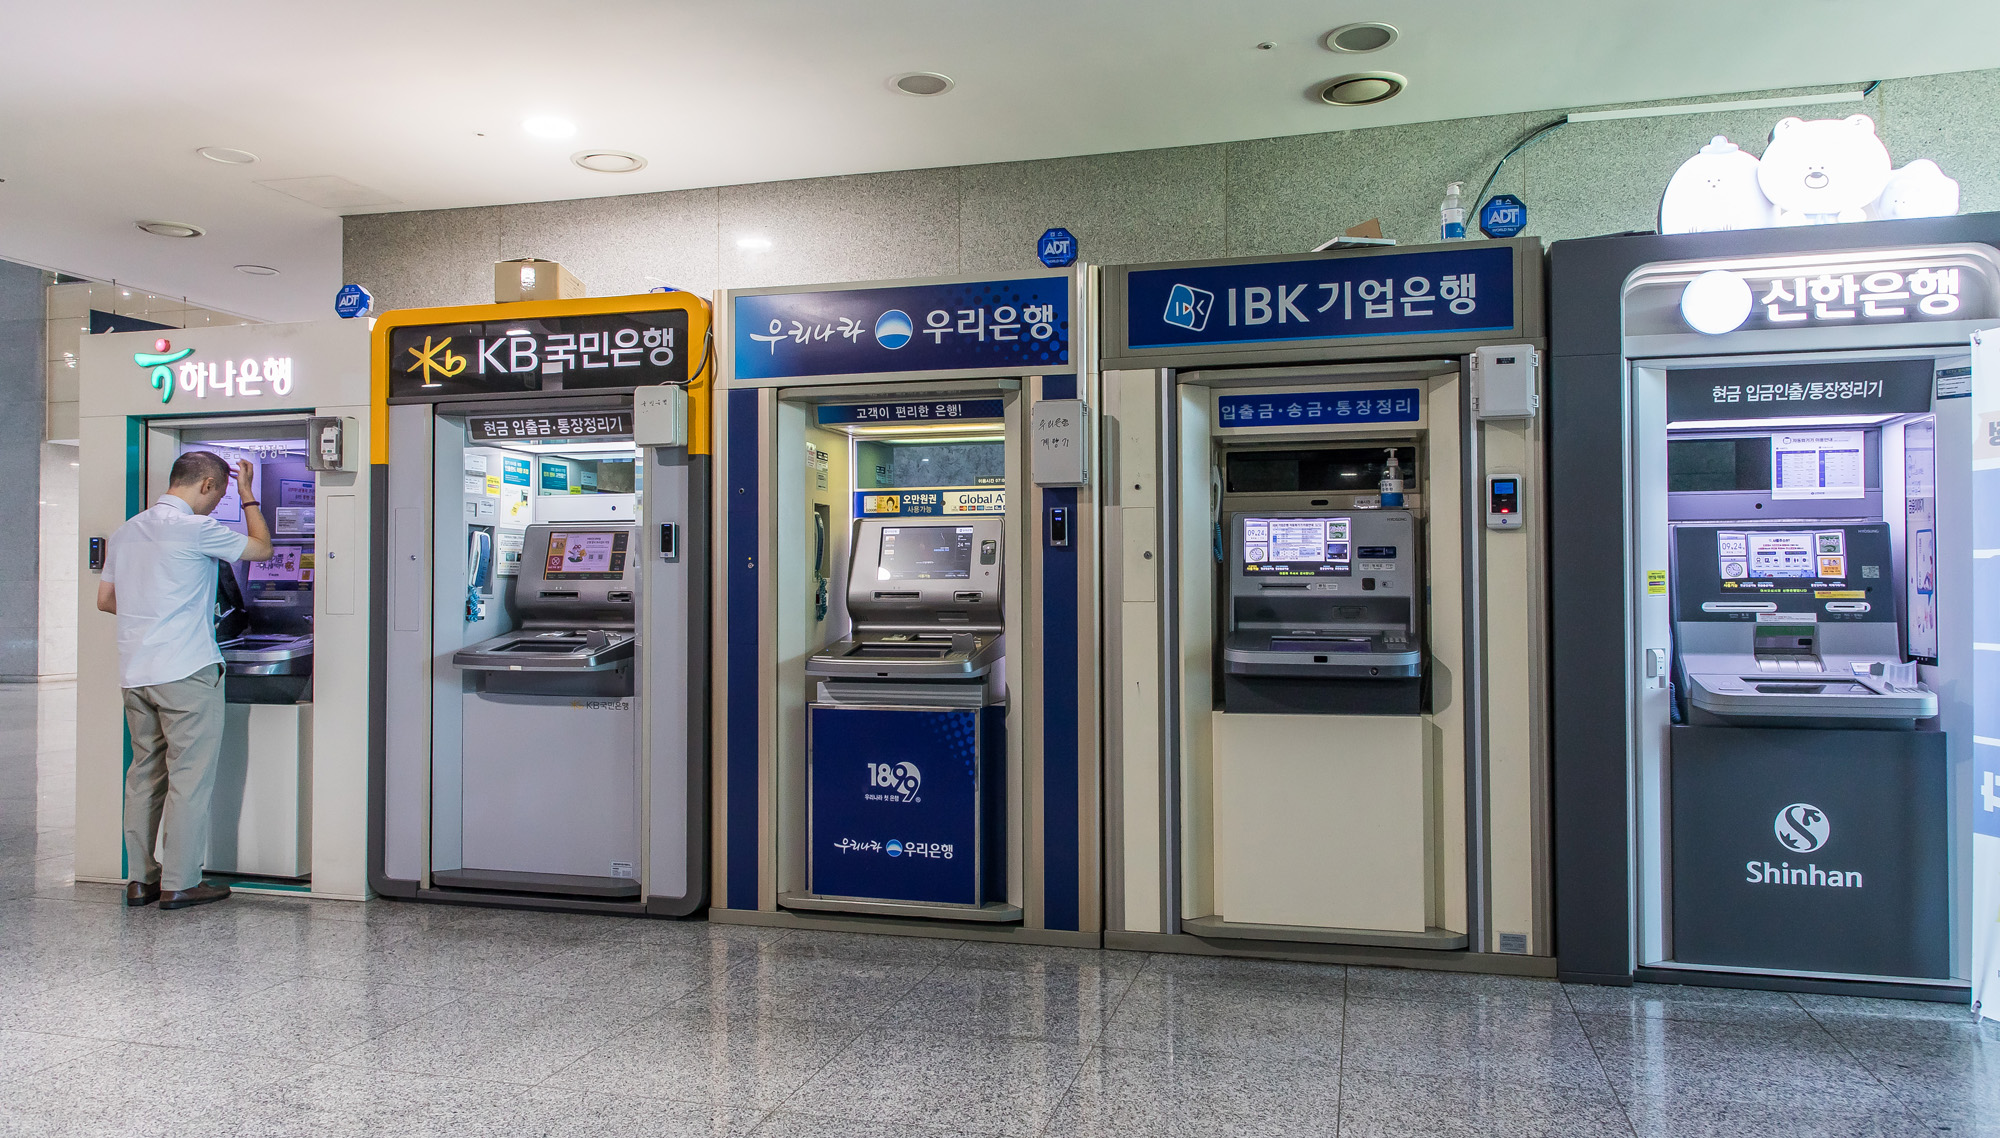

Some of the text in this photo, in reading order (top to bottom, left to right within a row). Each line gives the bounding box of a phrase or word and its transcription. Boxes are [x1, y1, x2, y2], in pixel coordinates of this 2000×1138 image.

[1488, 209, 1519, 225] ADT
[1044, 240, 1070, 255] ADT
[339, 294, 360, 307] ADT
[1761, 268, 1960, 322] 신한은행
[749, 304, 1054, 356] 우리나라 우리은행
[178, 356, 295, 399] 하나은행
[1712, 379, 1884, 403] 현금 입금인출/통장정리기
[856, 402, 962, 420] 고객이 편리한 은행!
[483, 420, 509, 437] 현금
[902, 493, 937, 505] 오만원권
[959, 493, 993, 505] Global
[907, 505, 932, 514] 사용가능
[867, 761, 922, 803] 1899
[889, 794, 900, 802] 은행
[833, 837, 954, 859] 우리나라 우리은행
[1745, 860, 1863, 888] Shinhan
